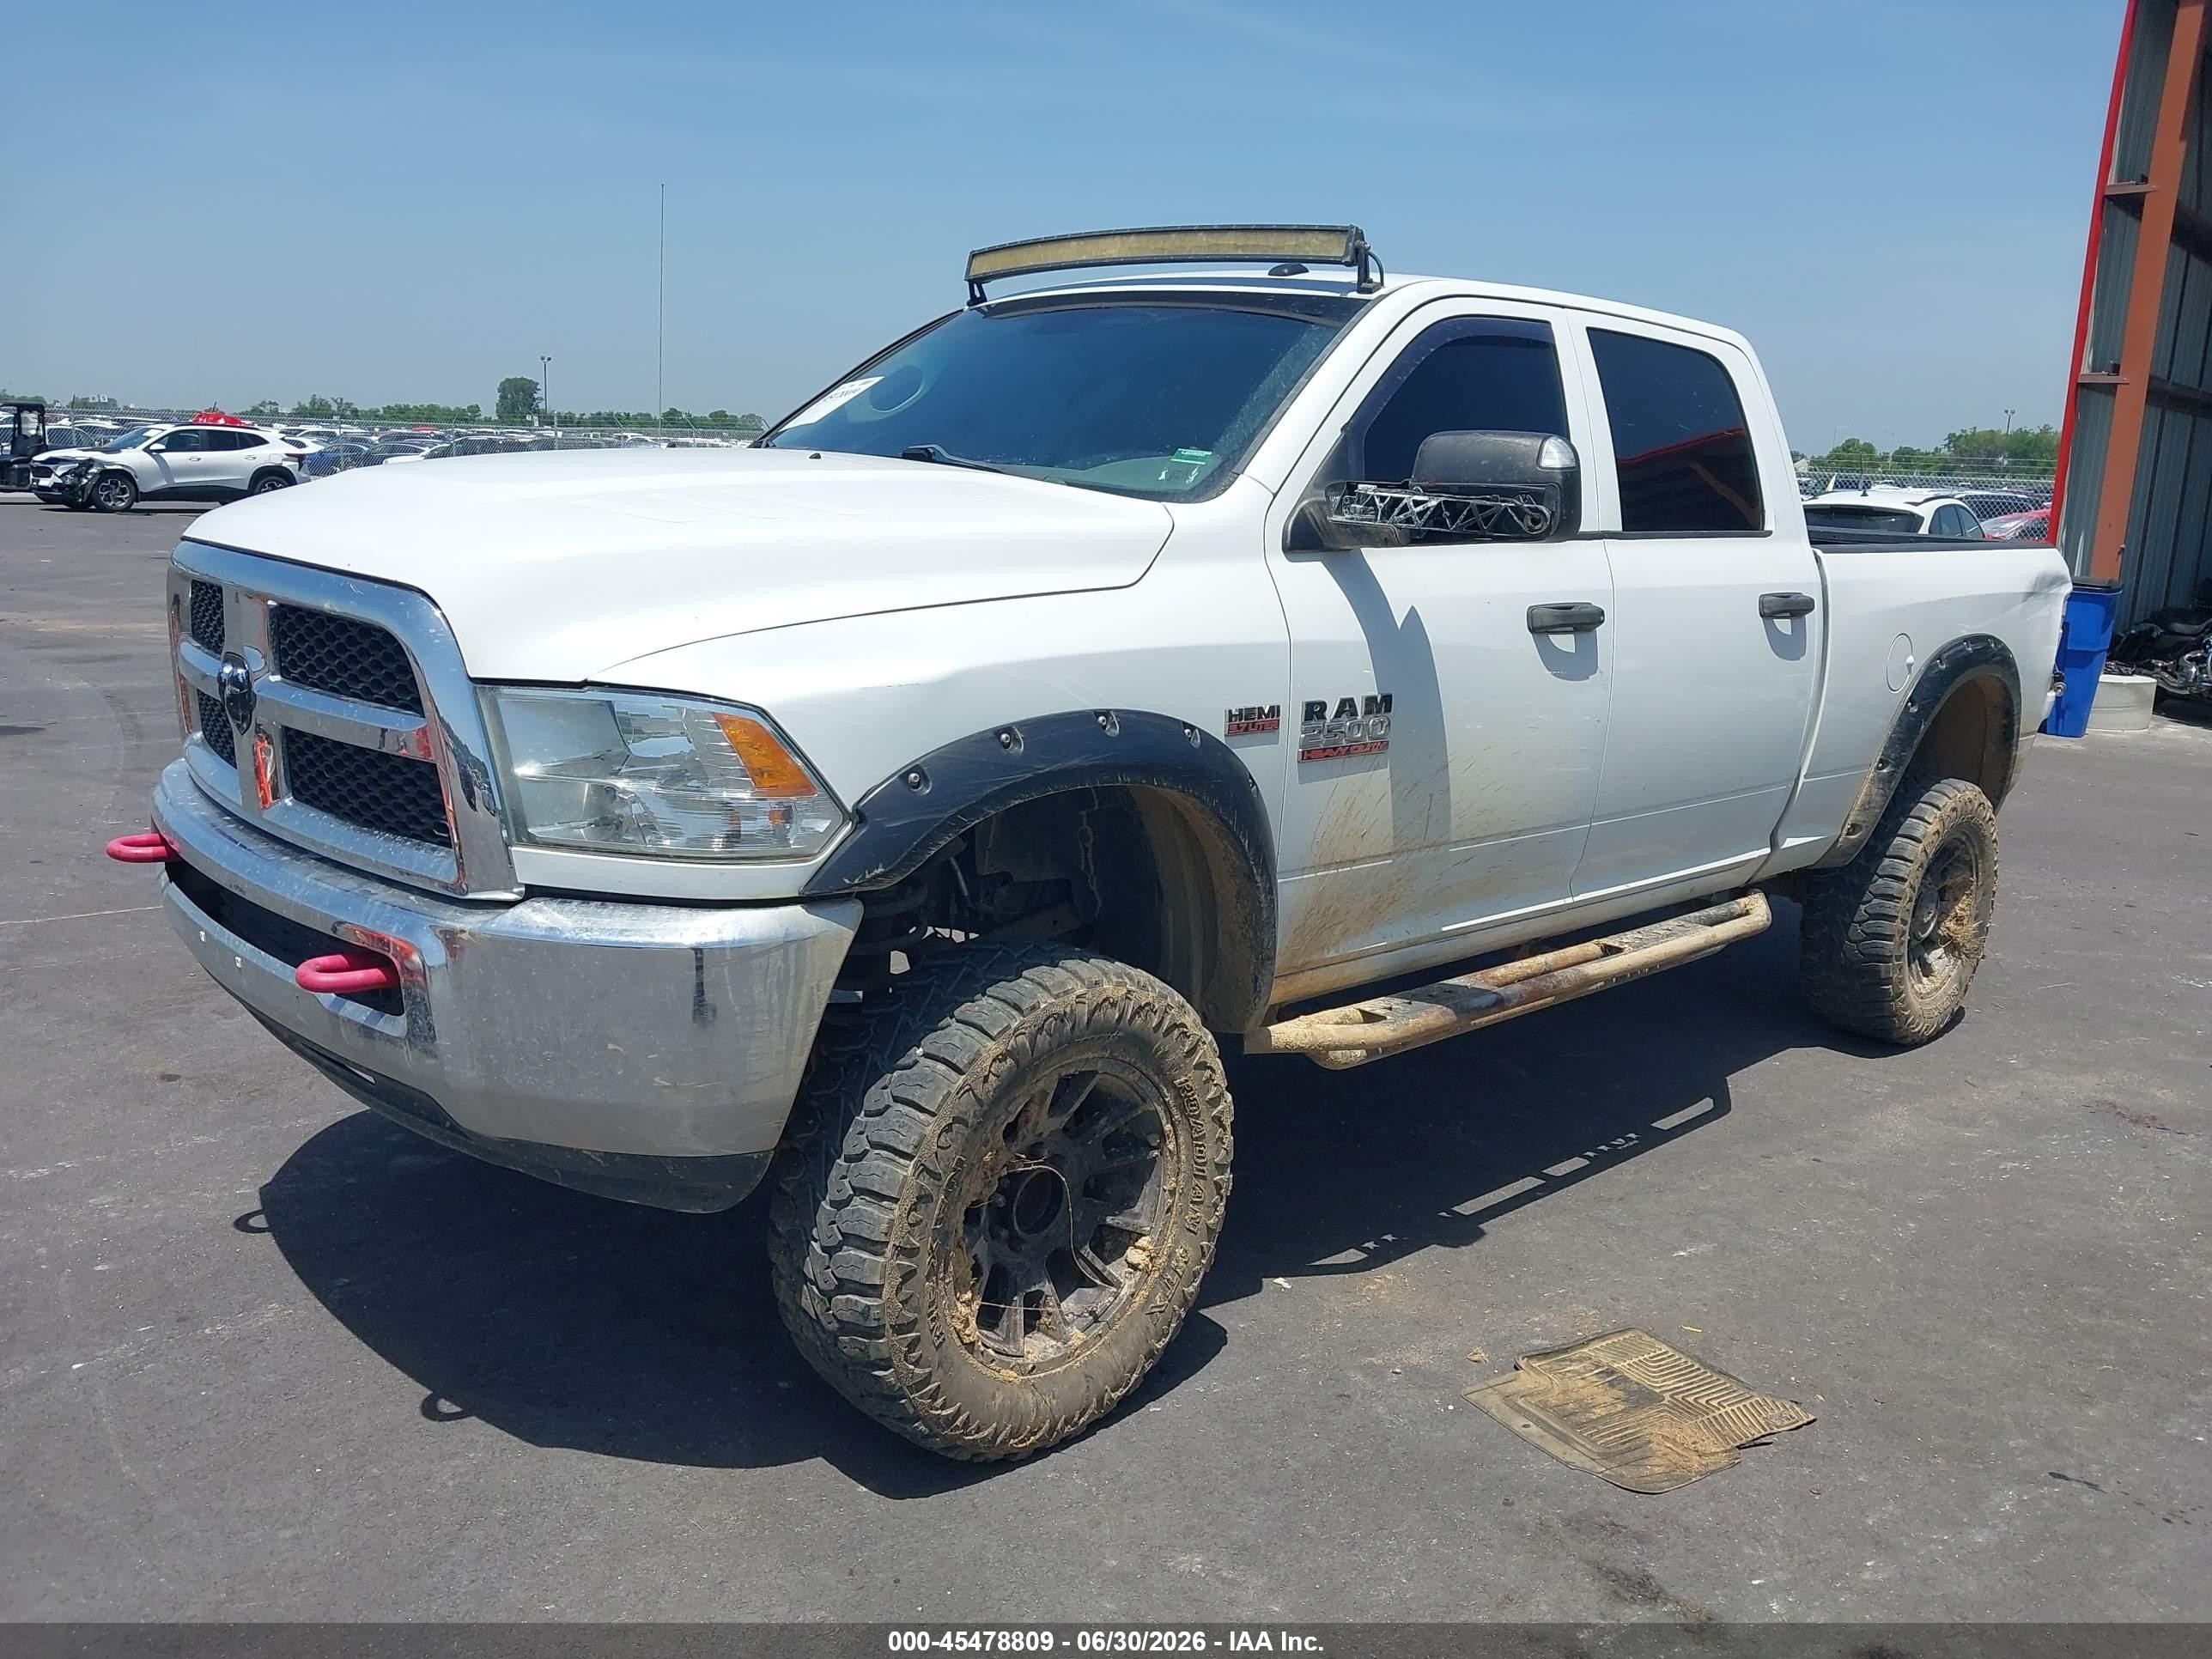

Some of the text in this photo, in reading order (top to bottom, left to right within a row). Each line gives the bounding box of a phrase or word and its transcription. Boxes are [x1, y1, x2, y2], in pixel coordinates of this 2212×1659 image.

[1225, 703, 1280, 723] HEMI
[1302, 693, 1394, 721] RAM
[1228, 720, 1279, 734] 5.7 LITER
[1301, 716, 1391, 748] 2500
[1303, 746, 1347, 760] HEAVY
[1174, 1077, 1206, 1235] ROADIAN
